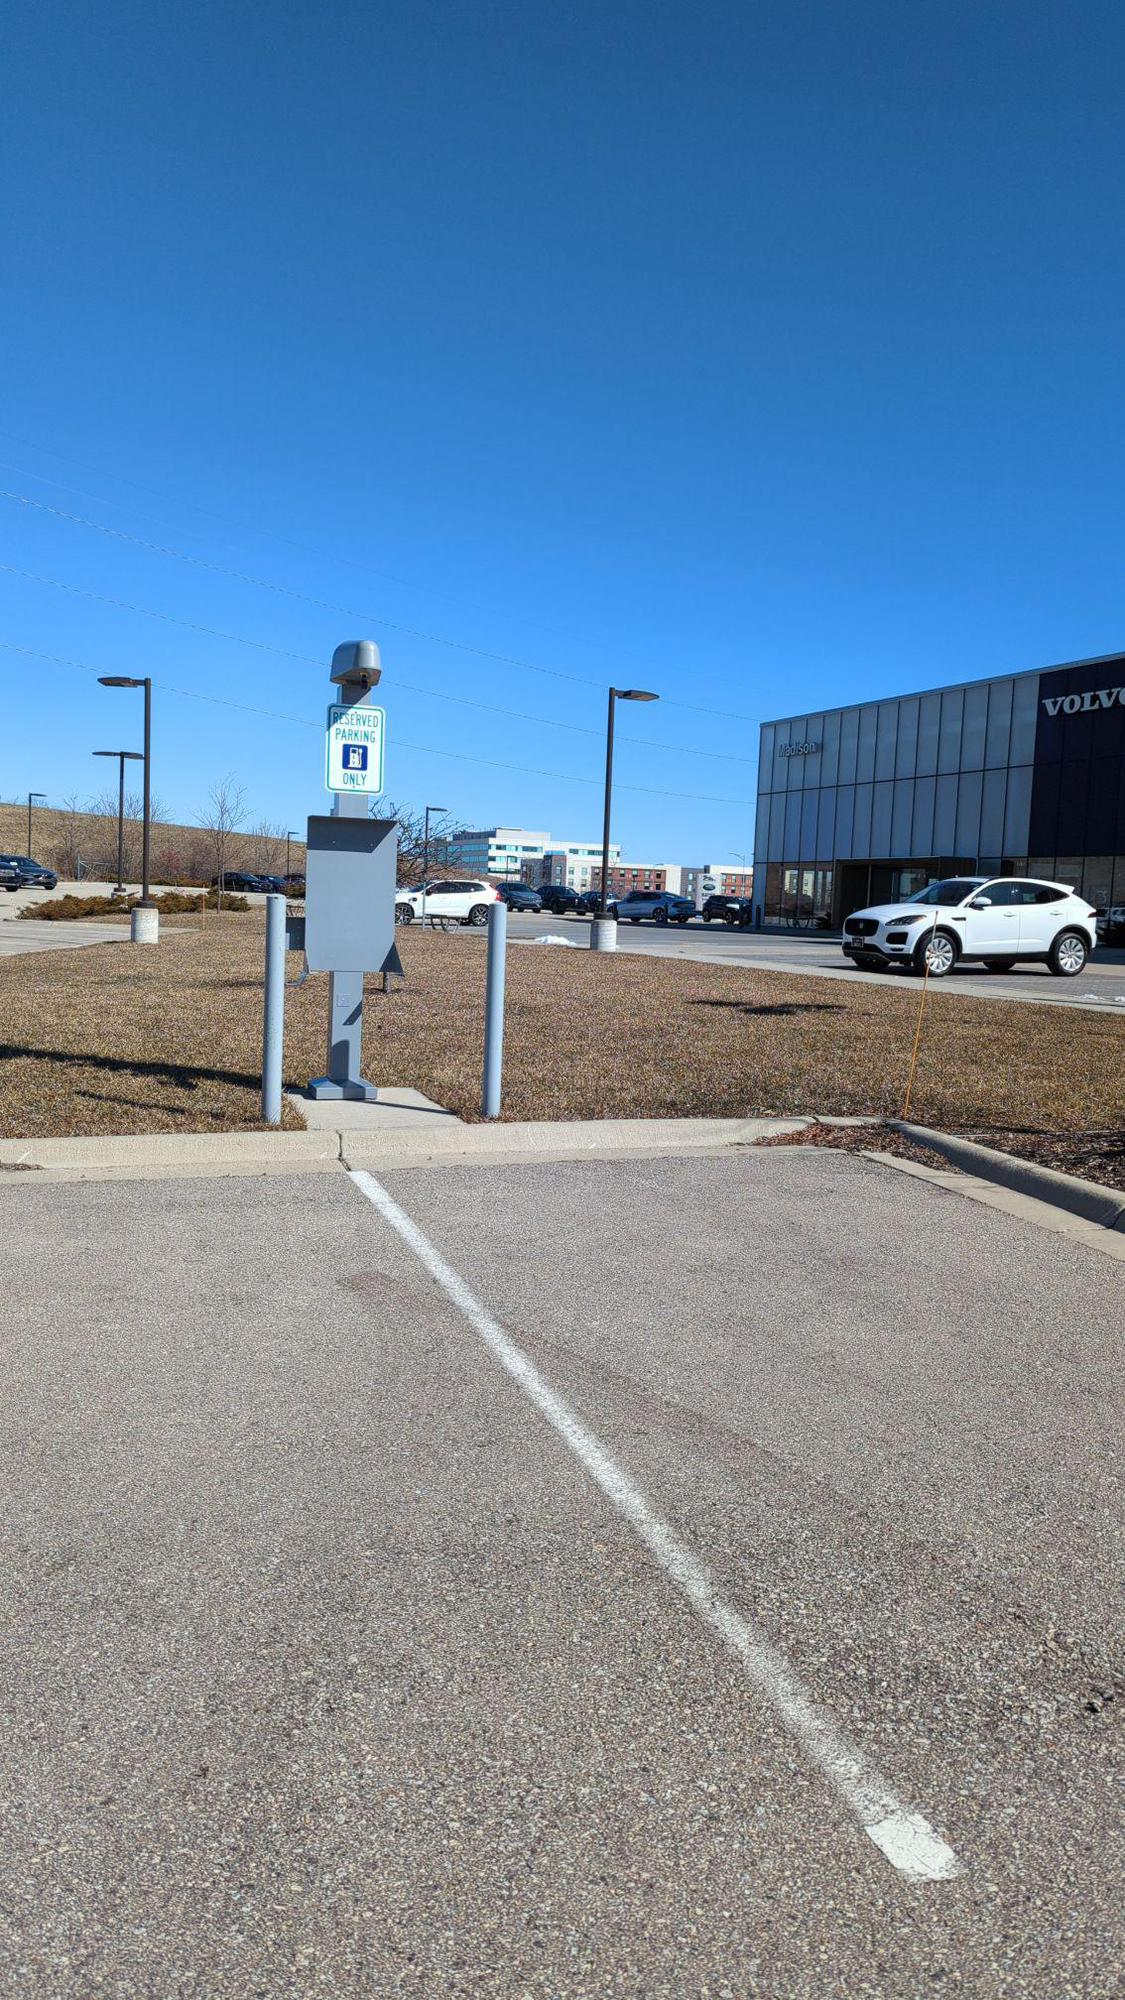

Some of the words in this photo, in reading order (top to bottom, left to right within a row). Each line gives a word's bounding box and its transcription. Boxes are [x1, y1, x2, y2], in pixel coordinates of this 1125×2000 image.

[332, 711, 379, 728] RESERVED
[335, 728, 376, 743] PARKING
[342, 773, 367, 786] ONLY
